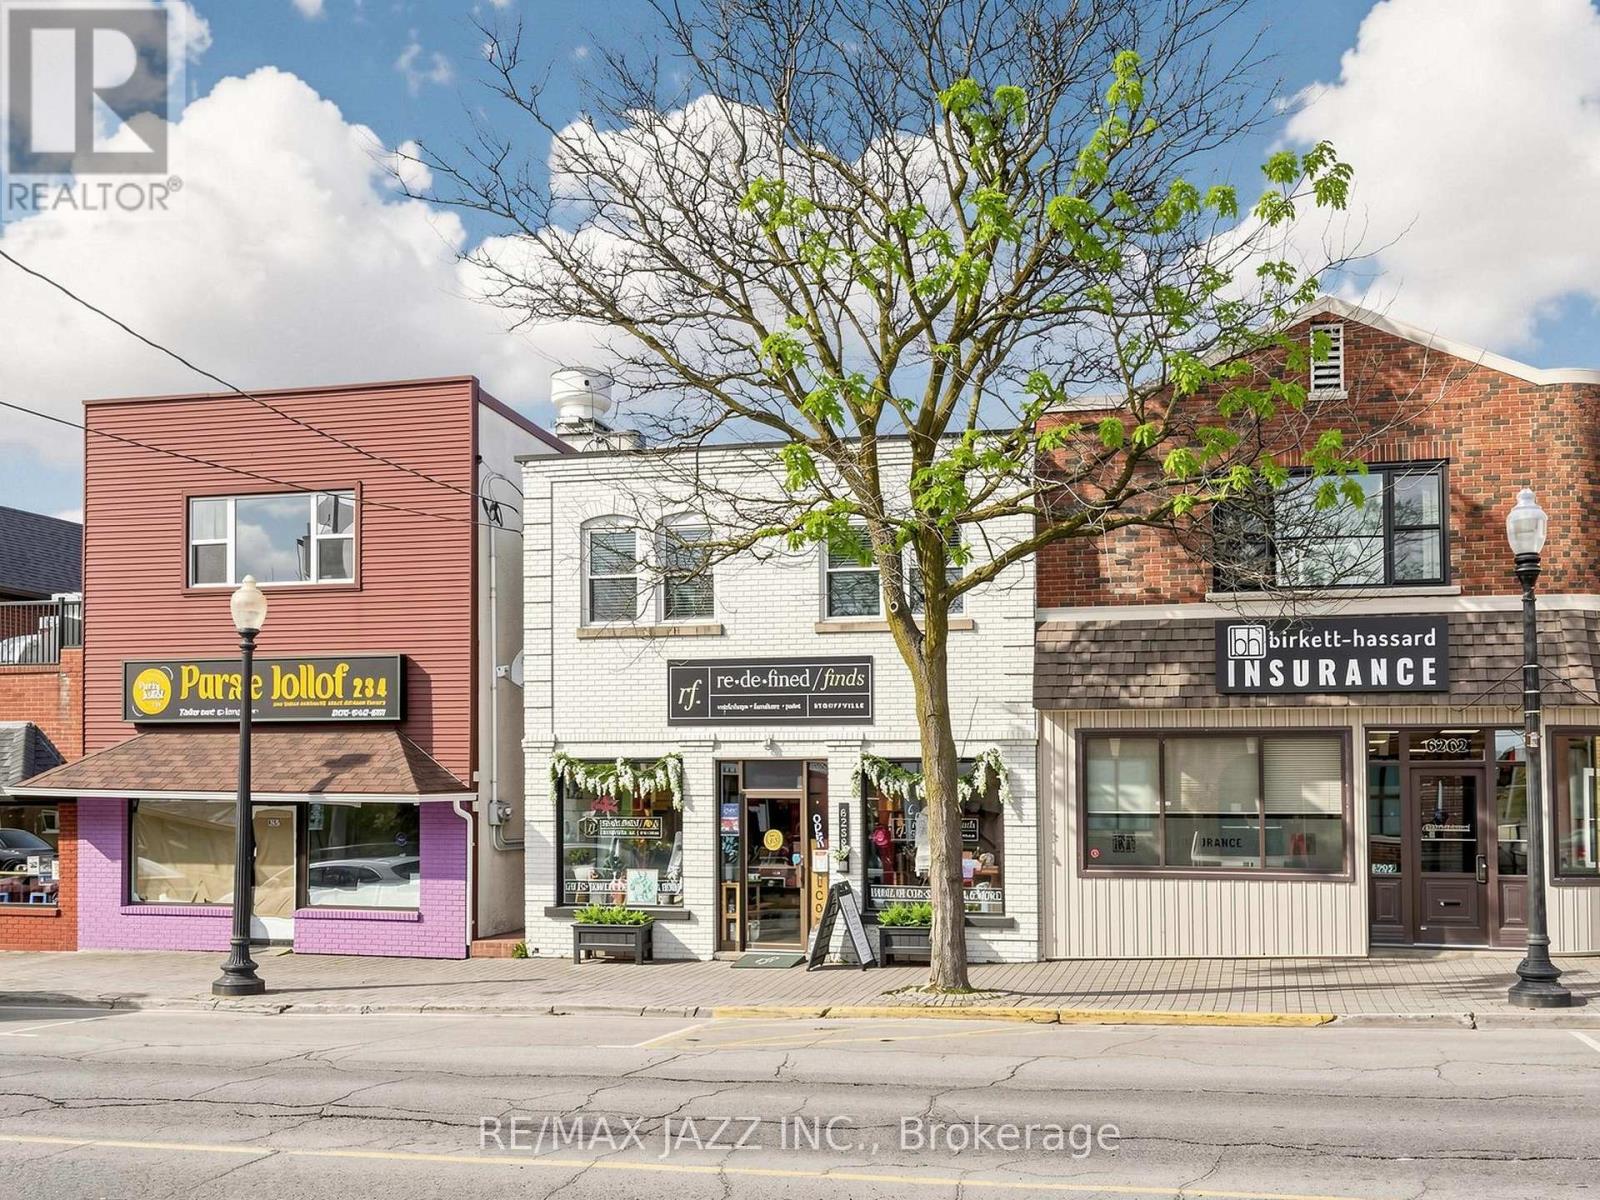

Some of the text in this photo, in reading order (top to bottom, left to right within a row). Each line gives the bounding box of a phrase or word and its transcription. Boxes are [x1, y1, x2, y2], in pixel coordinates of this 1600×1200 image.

[1269, 628, 1436, 648] birkett-hassard
[271, 663, 350, 700] Jollof
[353, 677, 388, 698] 234
[1227, 657, 1437, 687] INSURANCE
